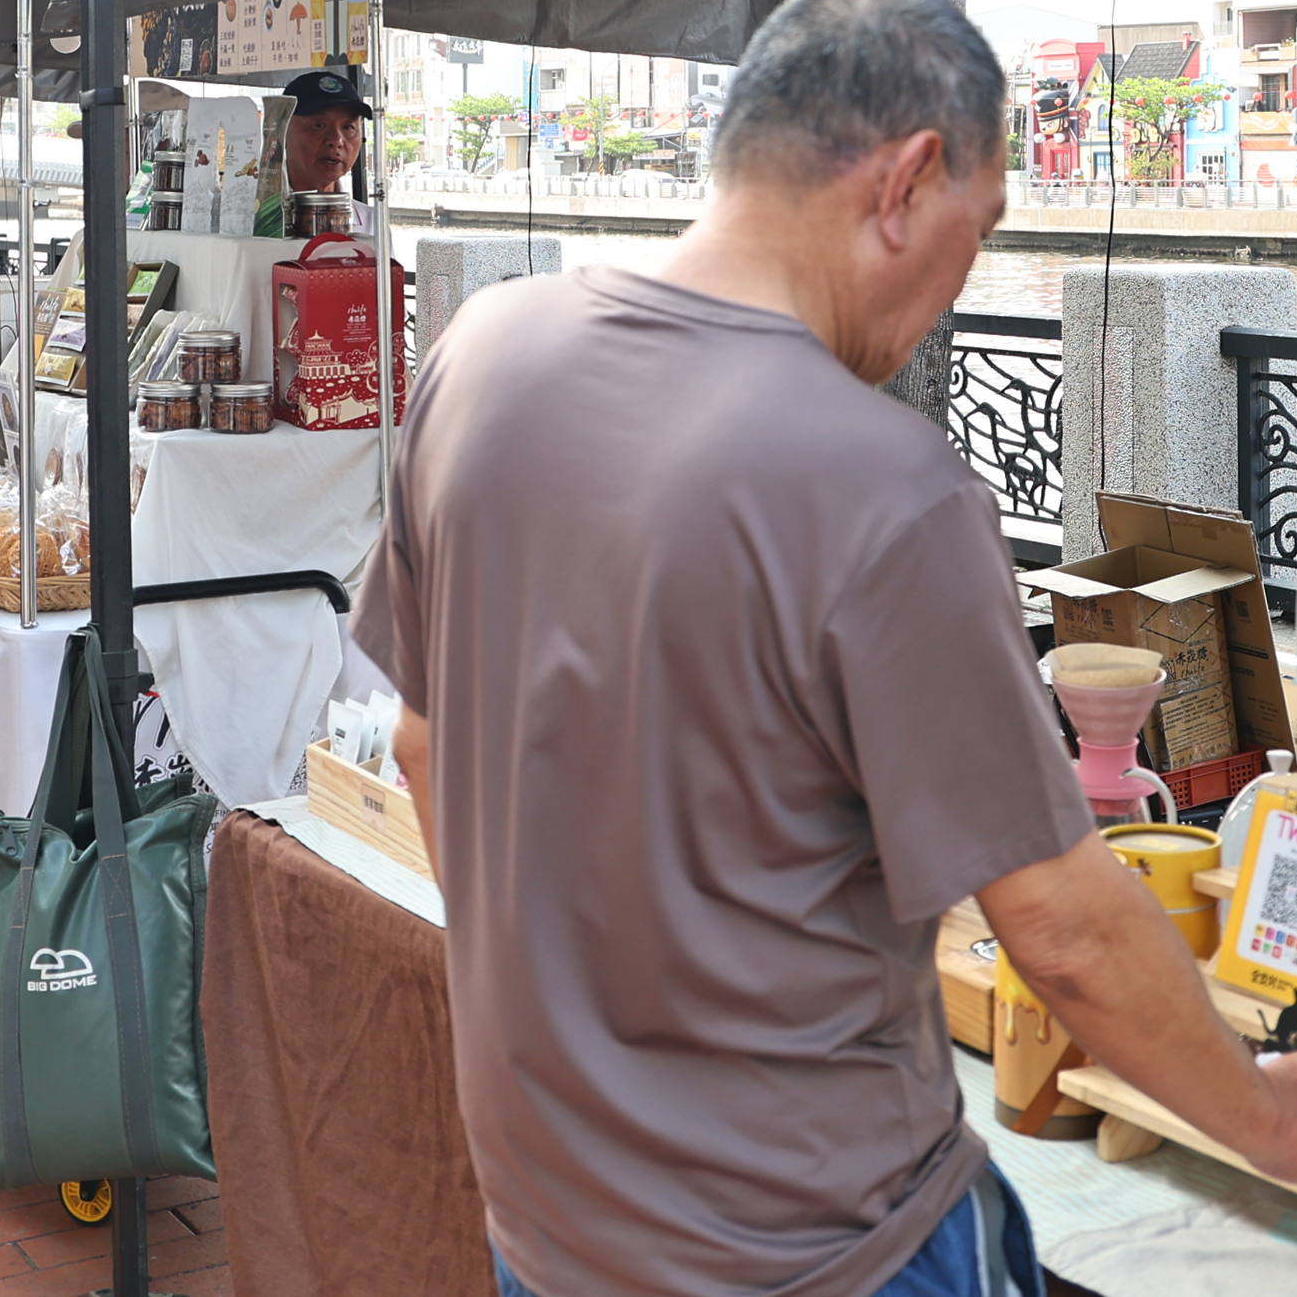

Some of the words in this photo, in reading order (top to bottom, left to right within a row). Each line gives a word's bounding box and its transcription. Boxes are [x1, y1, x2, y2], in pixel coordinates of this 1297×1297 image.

[1175, 646, 1209, 666] 赤崁糖
[27, 981, 48, 992] BIG
[50, 975, 97, 992] DOME
